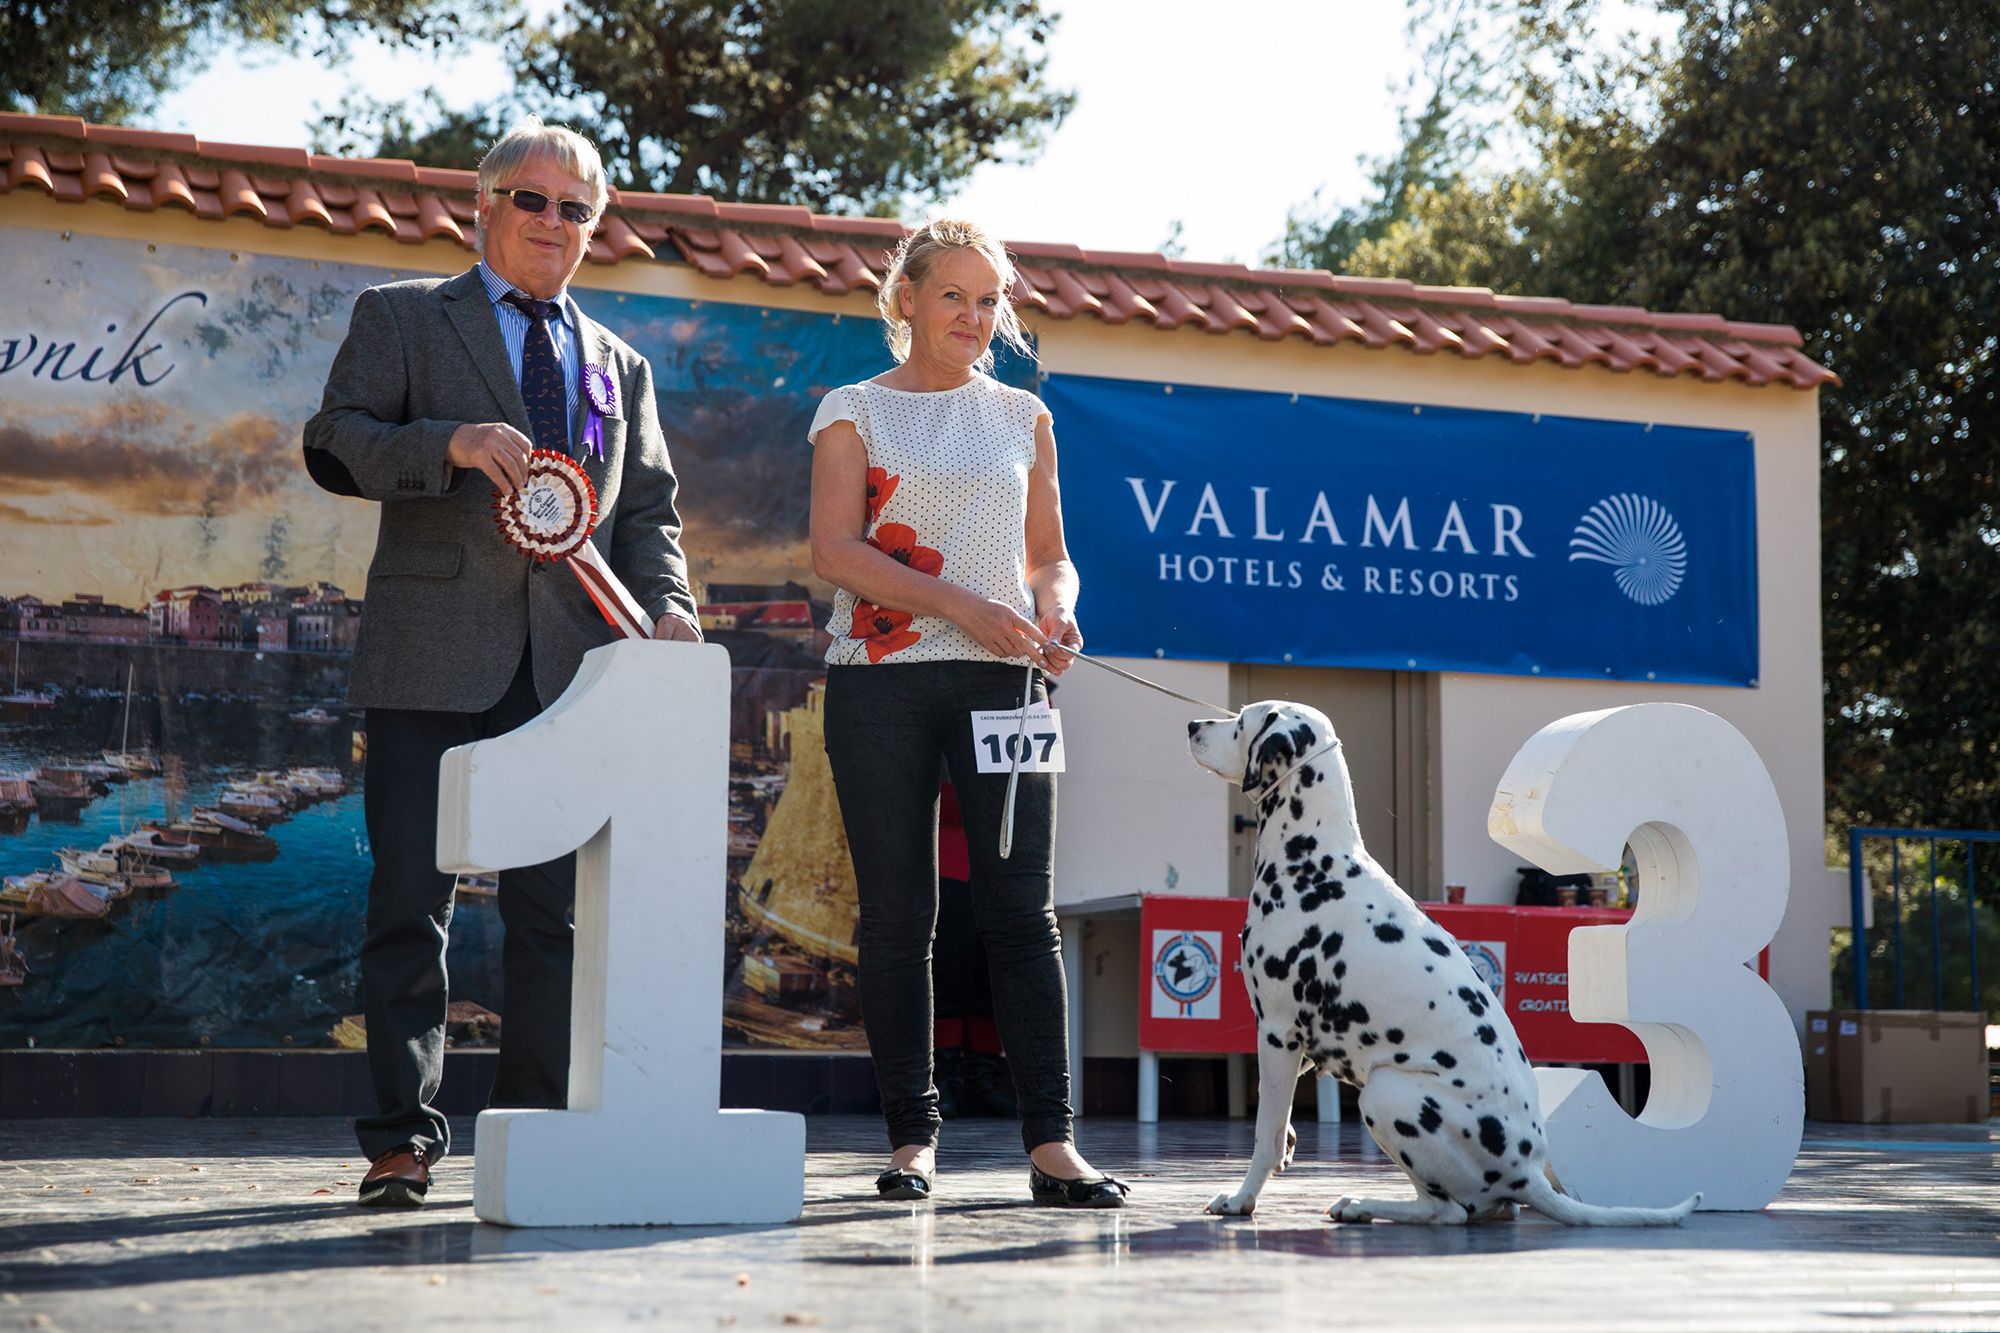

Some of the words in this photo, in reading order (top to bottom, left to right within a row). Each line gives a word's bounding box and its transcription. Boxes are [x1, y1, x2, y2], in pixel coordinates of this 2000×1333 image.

[1125, 477, 1536, 558] VALAMAR
[1159, 553, 1302, 588] HOTELS
[1321, 563, 1346, 591] &
[1364, 565, 1518, 601] RESORTS
[981, 733, 1057, 763] 107
[436, 638, 806, 1226] 1
[1488, 703, 1807, 1212] 3
[1519, 998, 1569, 1012] CROATI
